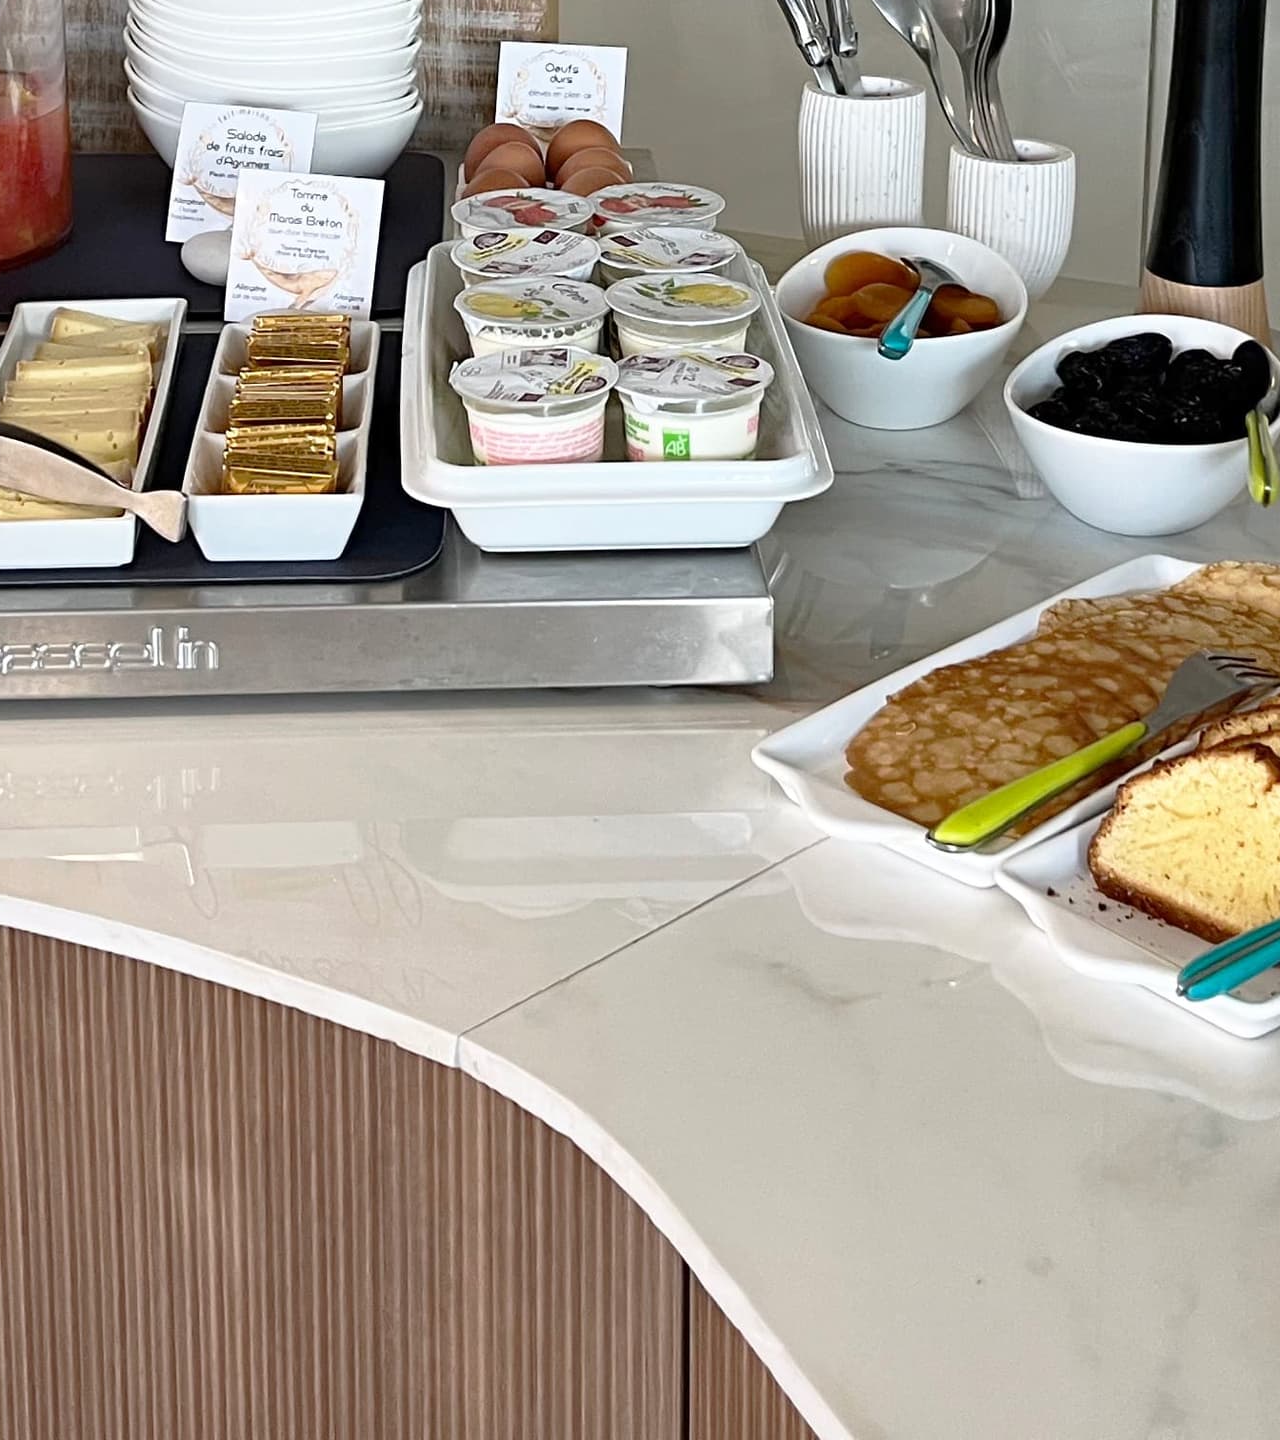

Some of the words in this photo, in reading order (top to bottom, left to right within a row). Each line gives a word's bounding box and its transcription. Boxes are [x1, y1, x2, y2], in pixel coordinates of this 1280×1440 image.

[545, 63, 579, 74] Oeufs
[550, 75, 573, 83] durs
[227, 128, 266, 142] Salade
[207, 142, 220, 151] de
[226, 143, 254, 154] fruits
[260, 147, 284, 158] frais
[216, 157, 269, 169] d'Agrumes
[291, 188, 328, 201] Tomme
[301, 203, 313, 212] du
[270, 213, 302, 224] Marais
[306, 216, 342, 228] Breton
